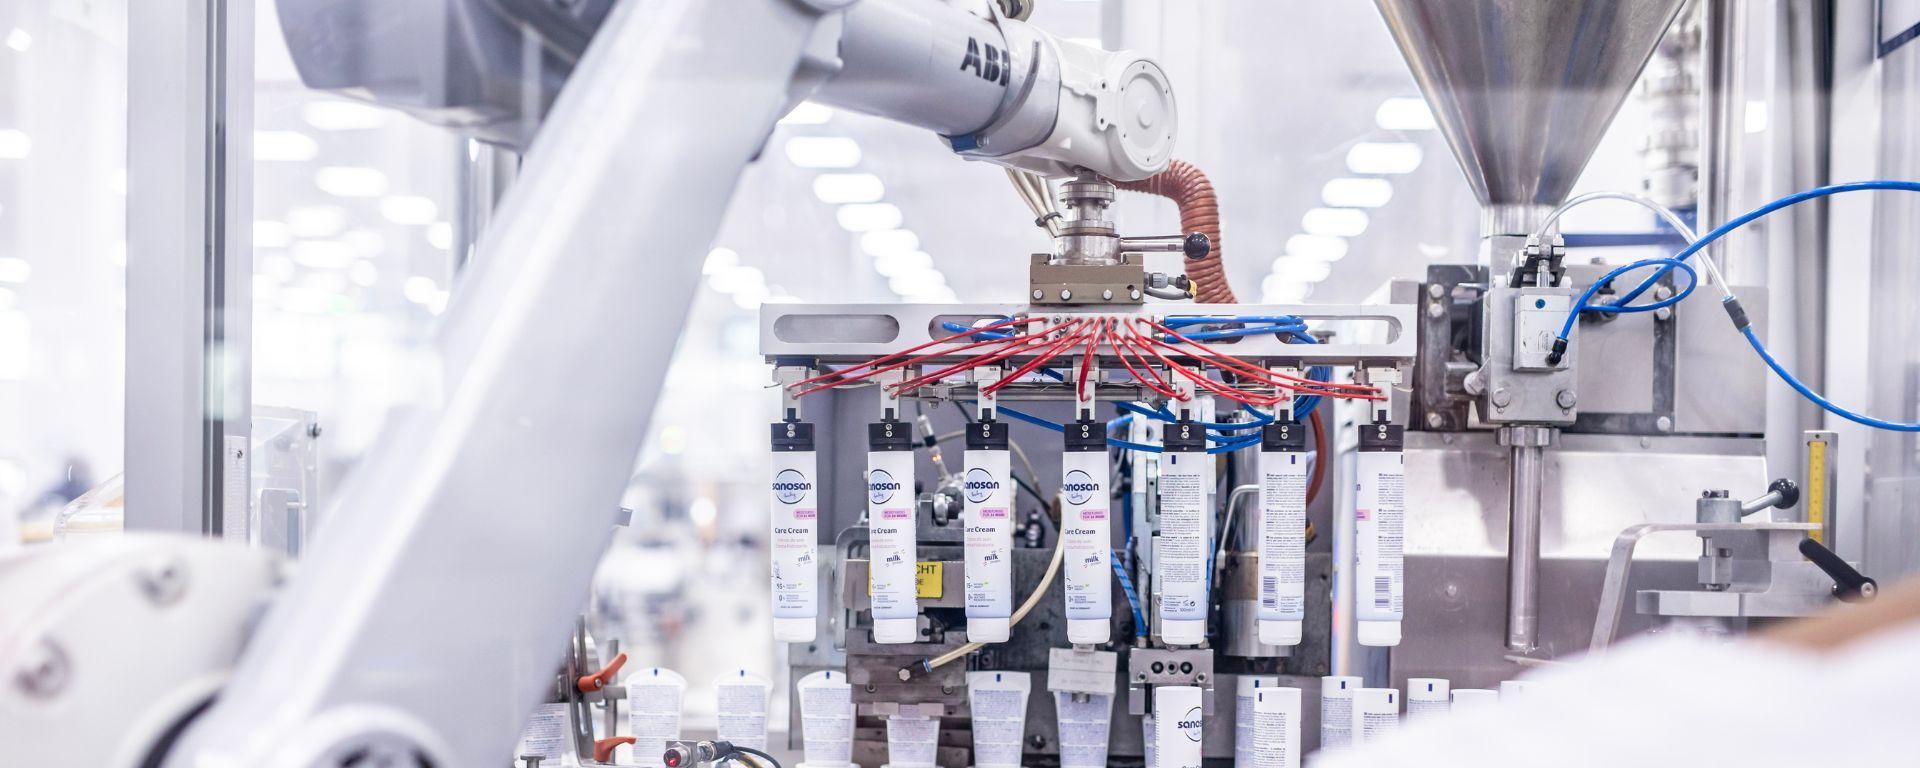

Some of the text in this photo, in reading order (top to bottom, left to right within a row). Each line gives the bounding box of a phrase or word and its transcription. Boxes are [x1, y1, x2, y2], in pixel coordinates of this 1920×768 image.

[868, 482, 901, 491] nosan
[964, 481, 1000, 490] anosan
[1064, 483, 1100, 492] anosan
